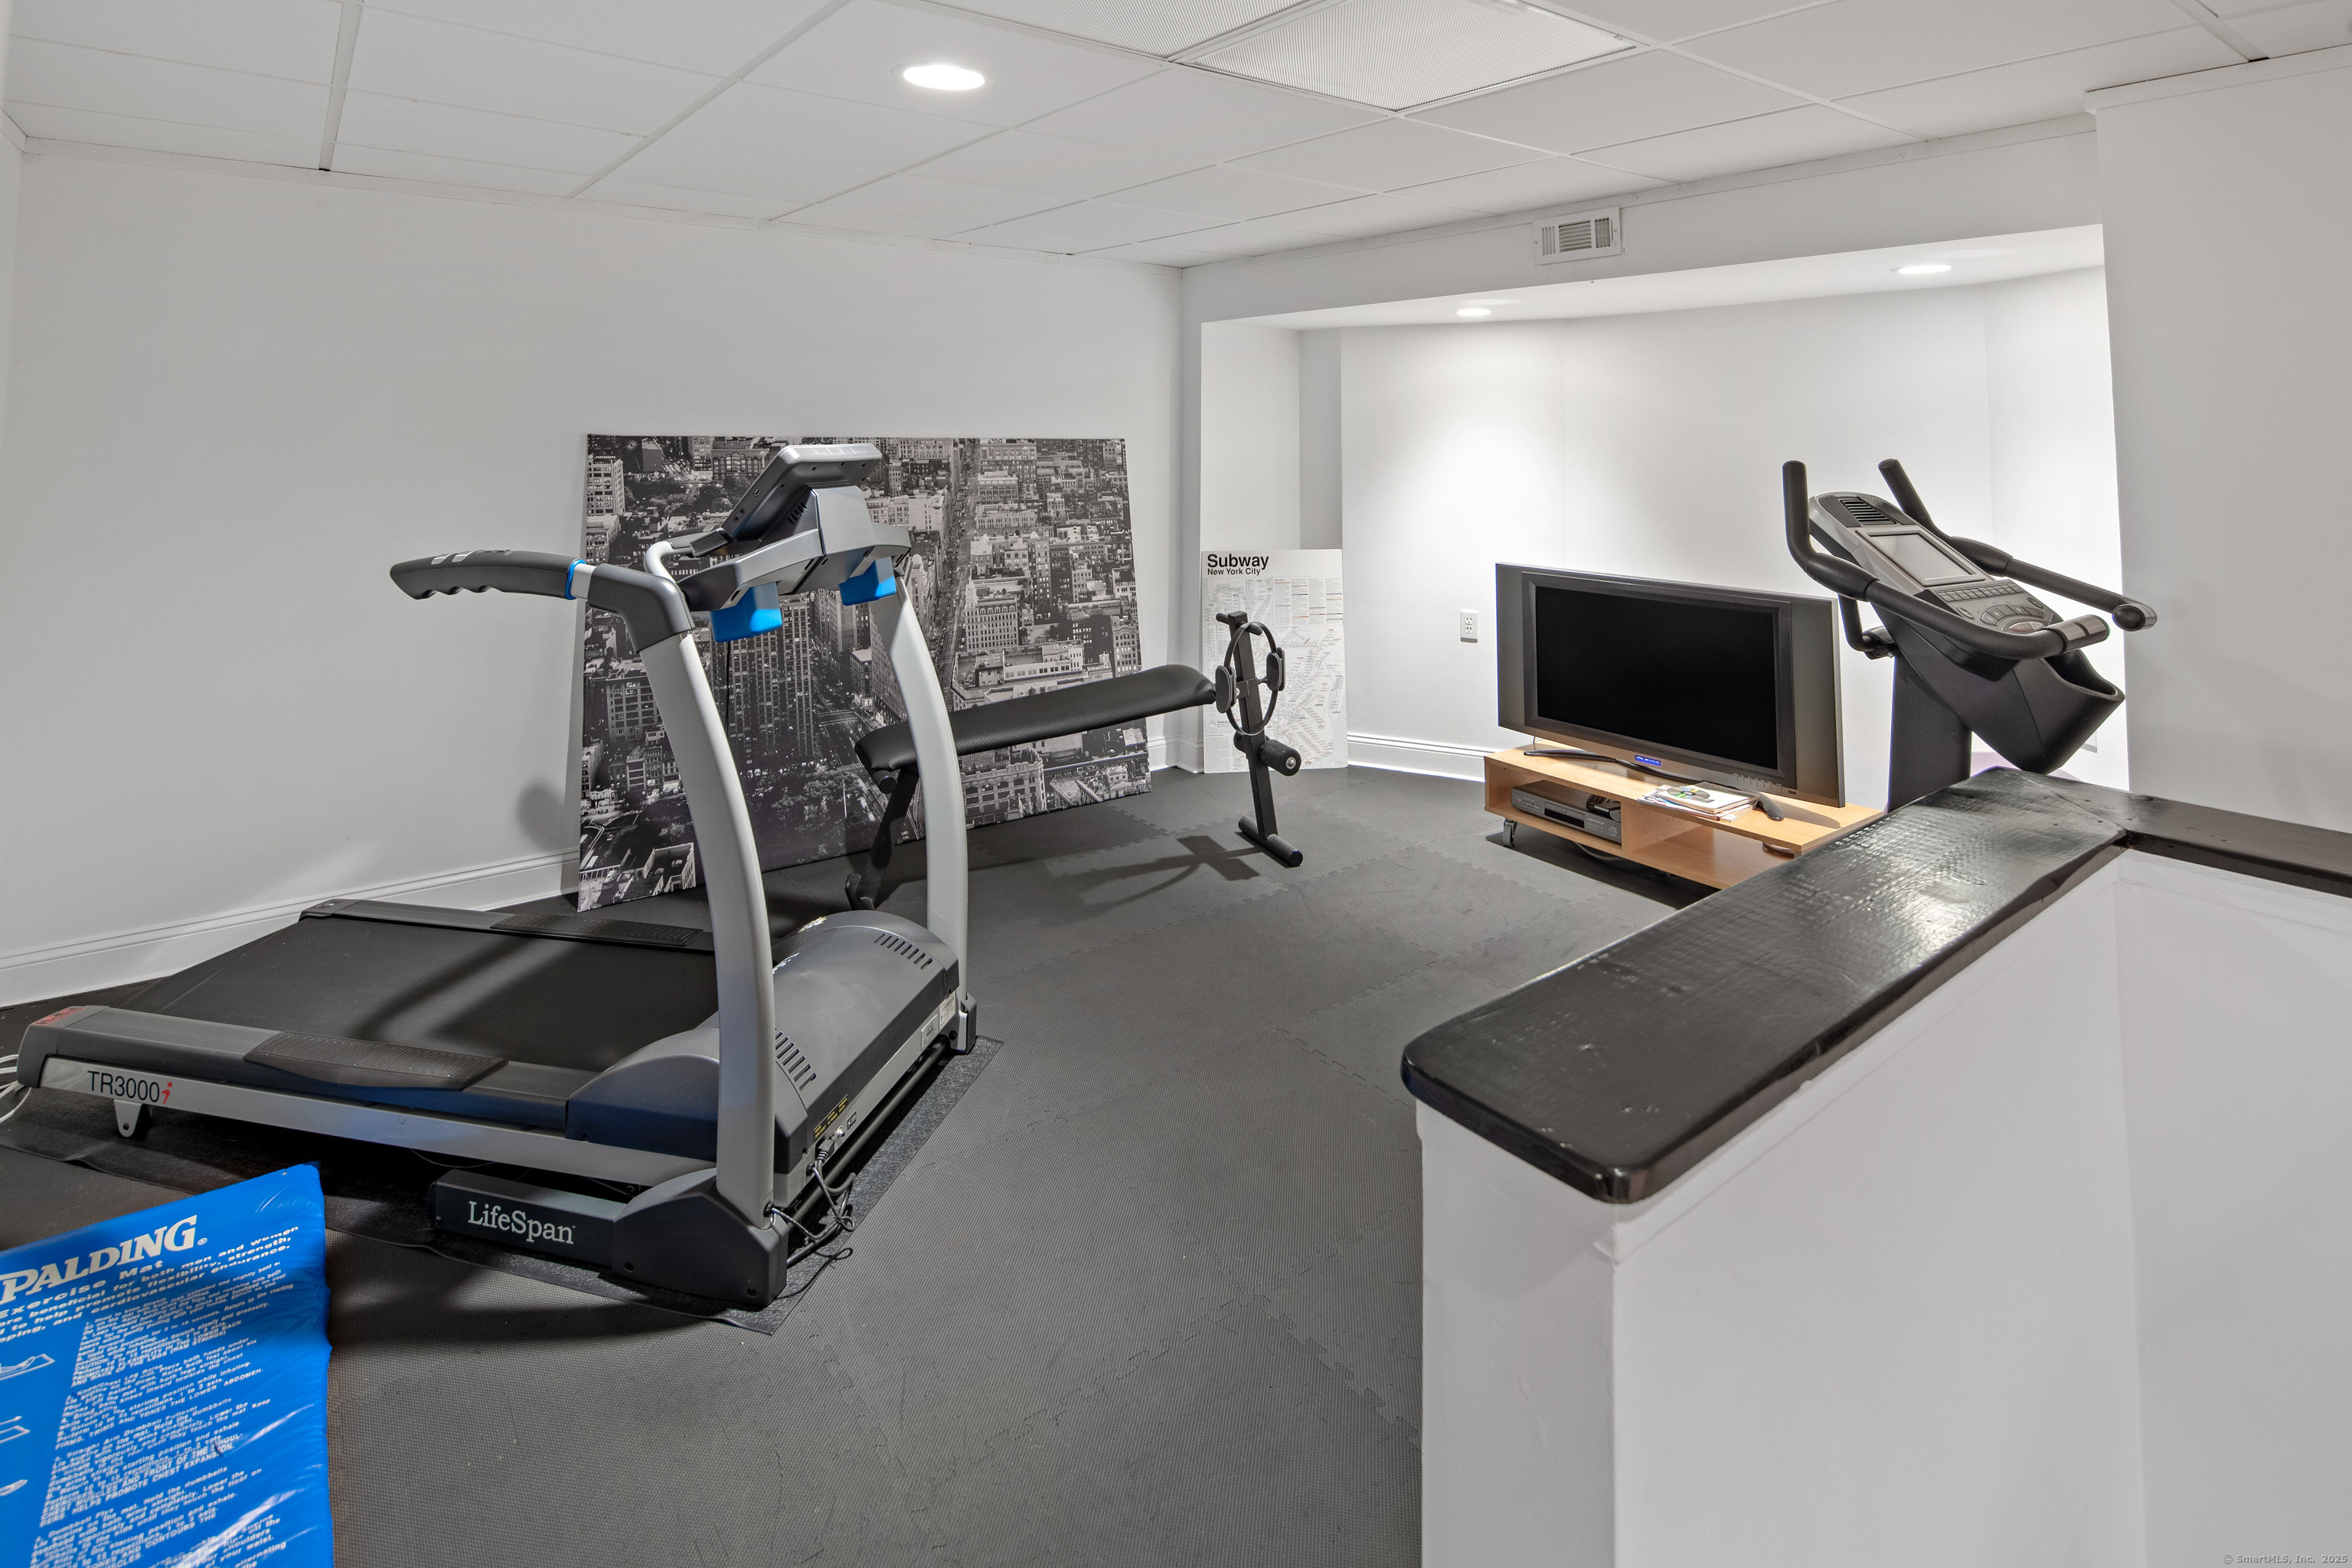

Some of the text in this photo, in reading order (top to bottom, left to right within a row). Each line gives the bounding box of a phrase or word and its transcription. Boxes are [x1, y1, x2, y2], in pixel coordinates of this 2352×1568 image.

[1207, 554, 1269, 570] Subway
[1246, 567, 1260, 576] City
[468, 1200, 573, 1244] LifeSpan
[29, 1290, 106, 1318] beneficial
[113, 1280, 135, 1292] for
[142, 1267, 175, 1282] both
[181, 1256, 212, 1269] men
[218, 1244, 244, 1257] and
[250, 1226, 299, 1246] women
[53, 1312, 83, 1325] and
[91, 1272, 205, 1314] cardiovascular
[211, 1245, 290, 1273] endurance.
[119, 1260, 163, 1279] Mat
[11, 1321, 28, 1331] to
[34, 1309, 68, 1325] help
[76, 1286, 141, 1312] promote
